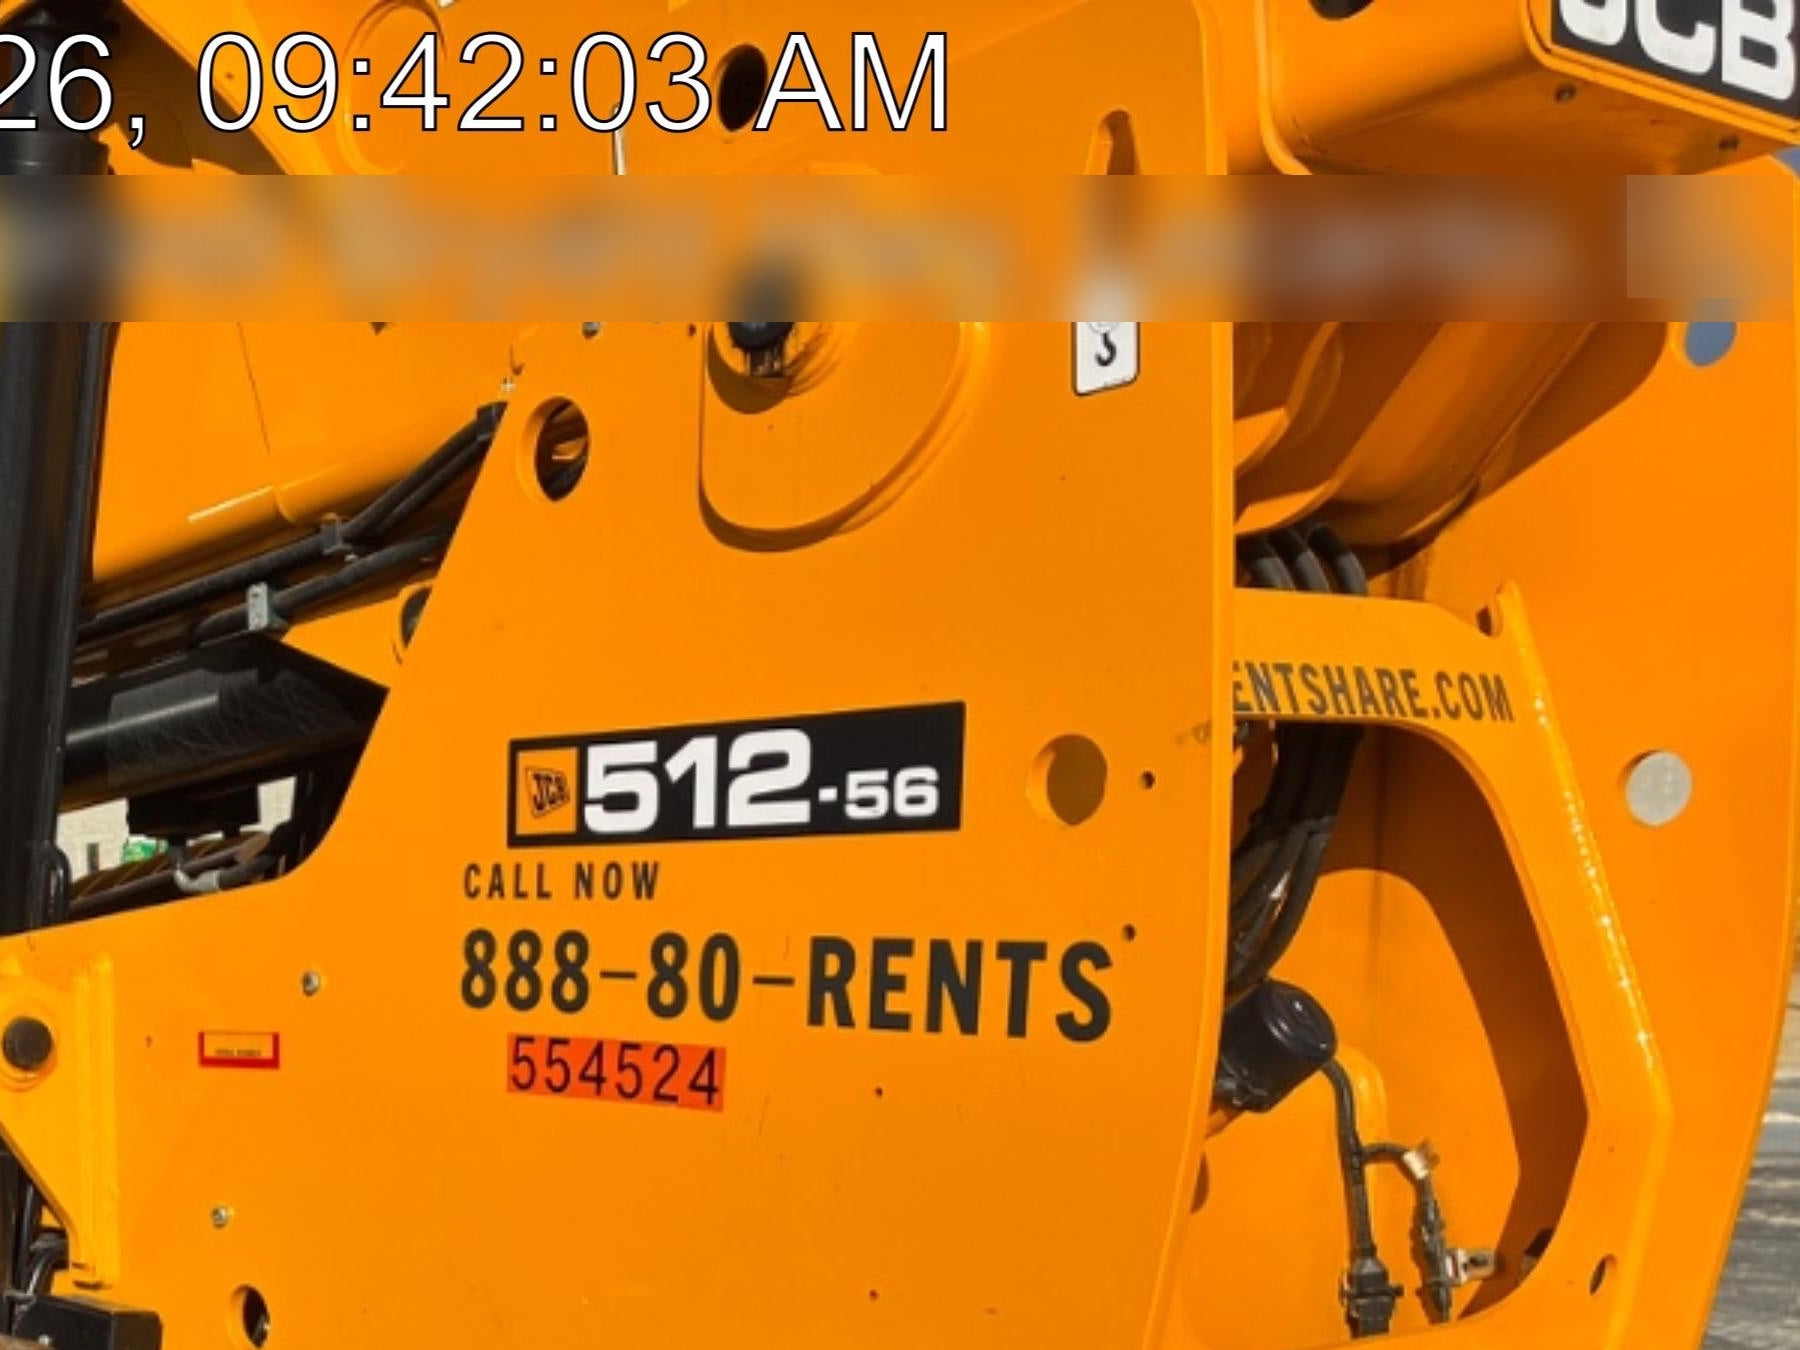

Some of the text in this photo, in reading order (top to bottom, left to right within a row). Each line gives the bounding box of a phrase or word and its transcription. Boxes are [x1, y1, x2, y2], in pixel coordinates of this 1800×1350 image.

[1232, 660, 1516, 722] ENTSHARE.COM
[584, 727, 941, 834] 512-56
[463, 861, 660, 900] CALL NOW
[460, 928, 1114, 1044] 888-80-RENTS
[510, 1034, 722, 1105] 554524
